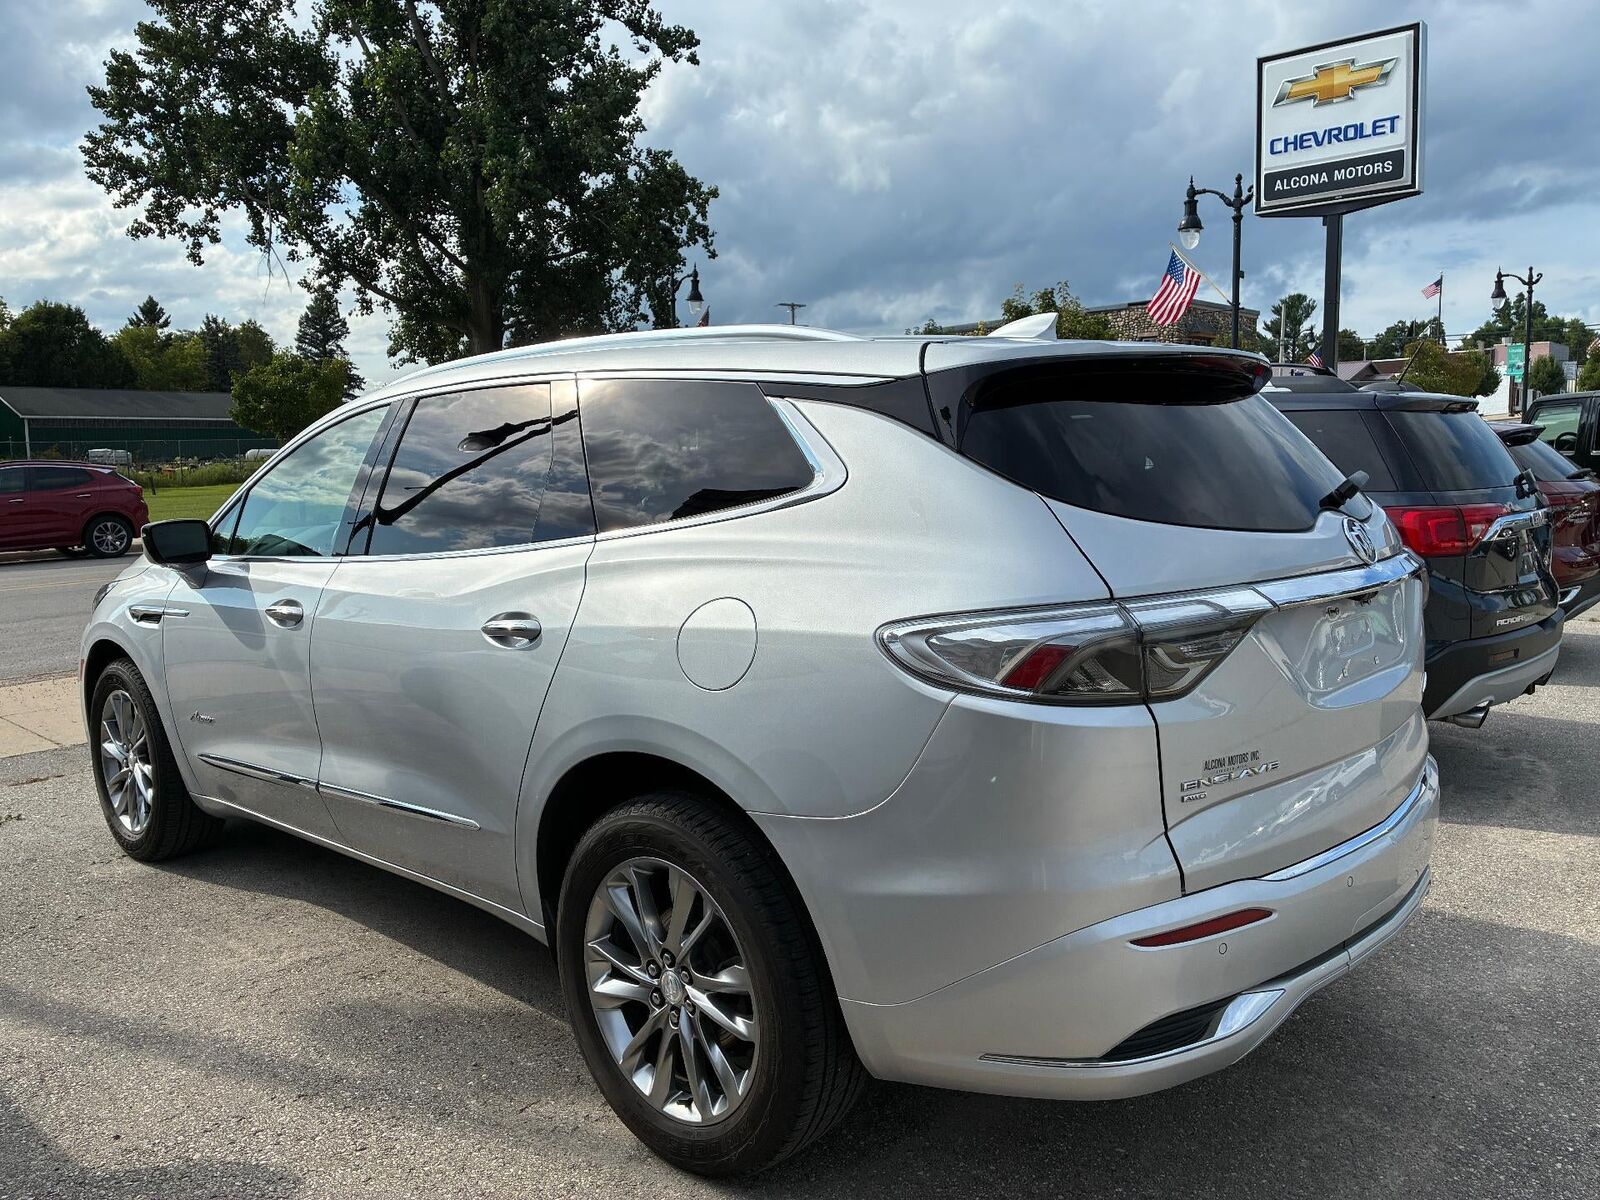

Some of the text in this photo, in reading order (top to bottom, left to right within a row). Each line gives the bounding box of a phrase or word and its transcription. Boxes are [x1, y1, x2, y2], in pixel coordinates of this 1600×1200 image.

[1269, 114, 1400, 156] CHEVROLET
[1274, 160, 1393, 192] ALCONA MOTORS
[1180, 760, 1280, 793] ENCLAVE
[1203, 757, 1226, 771] ALCONA
[1227, 752, 1249, 767] MOTORS
